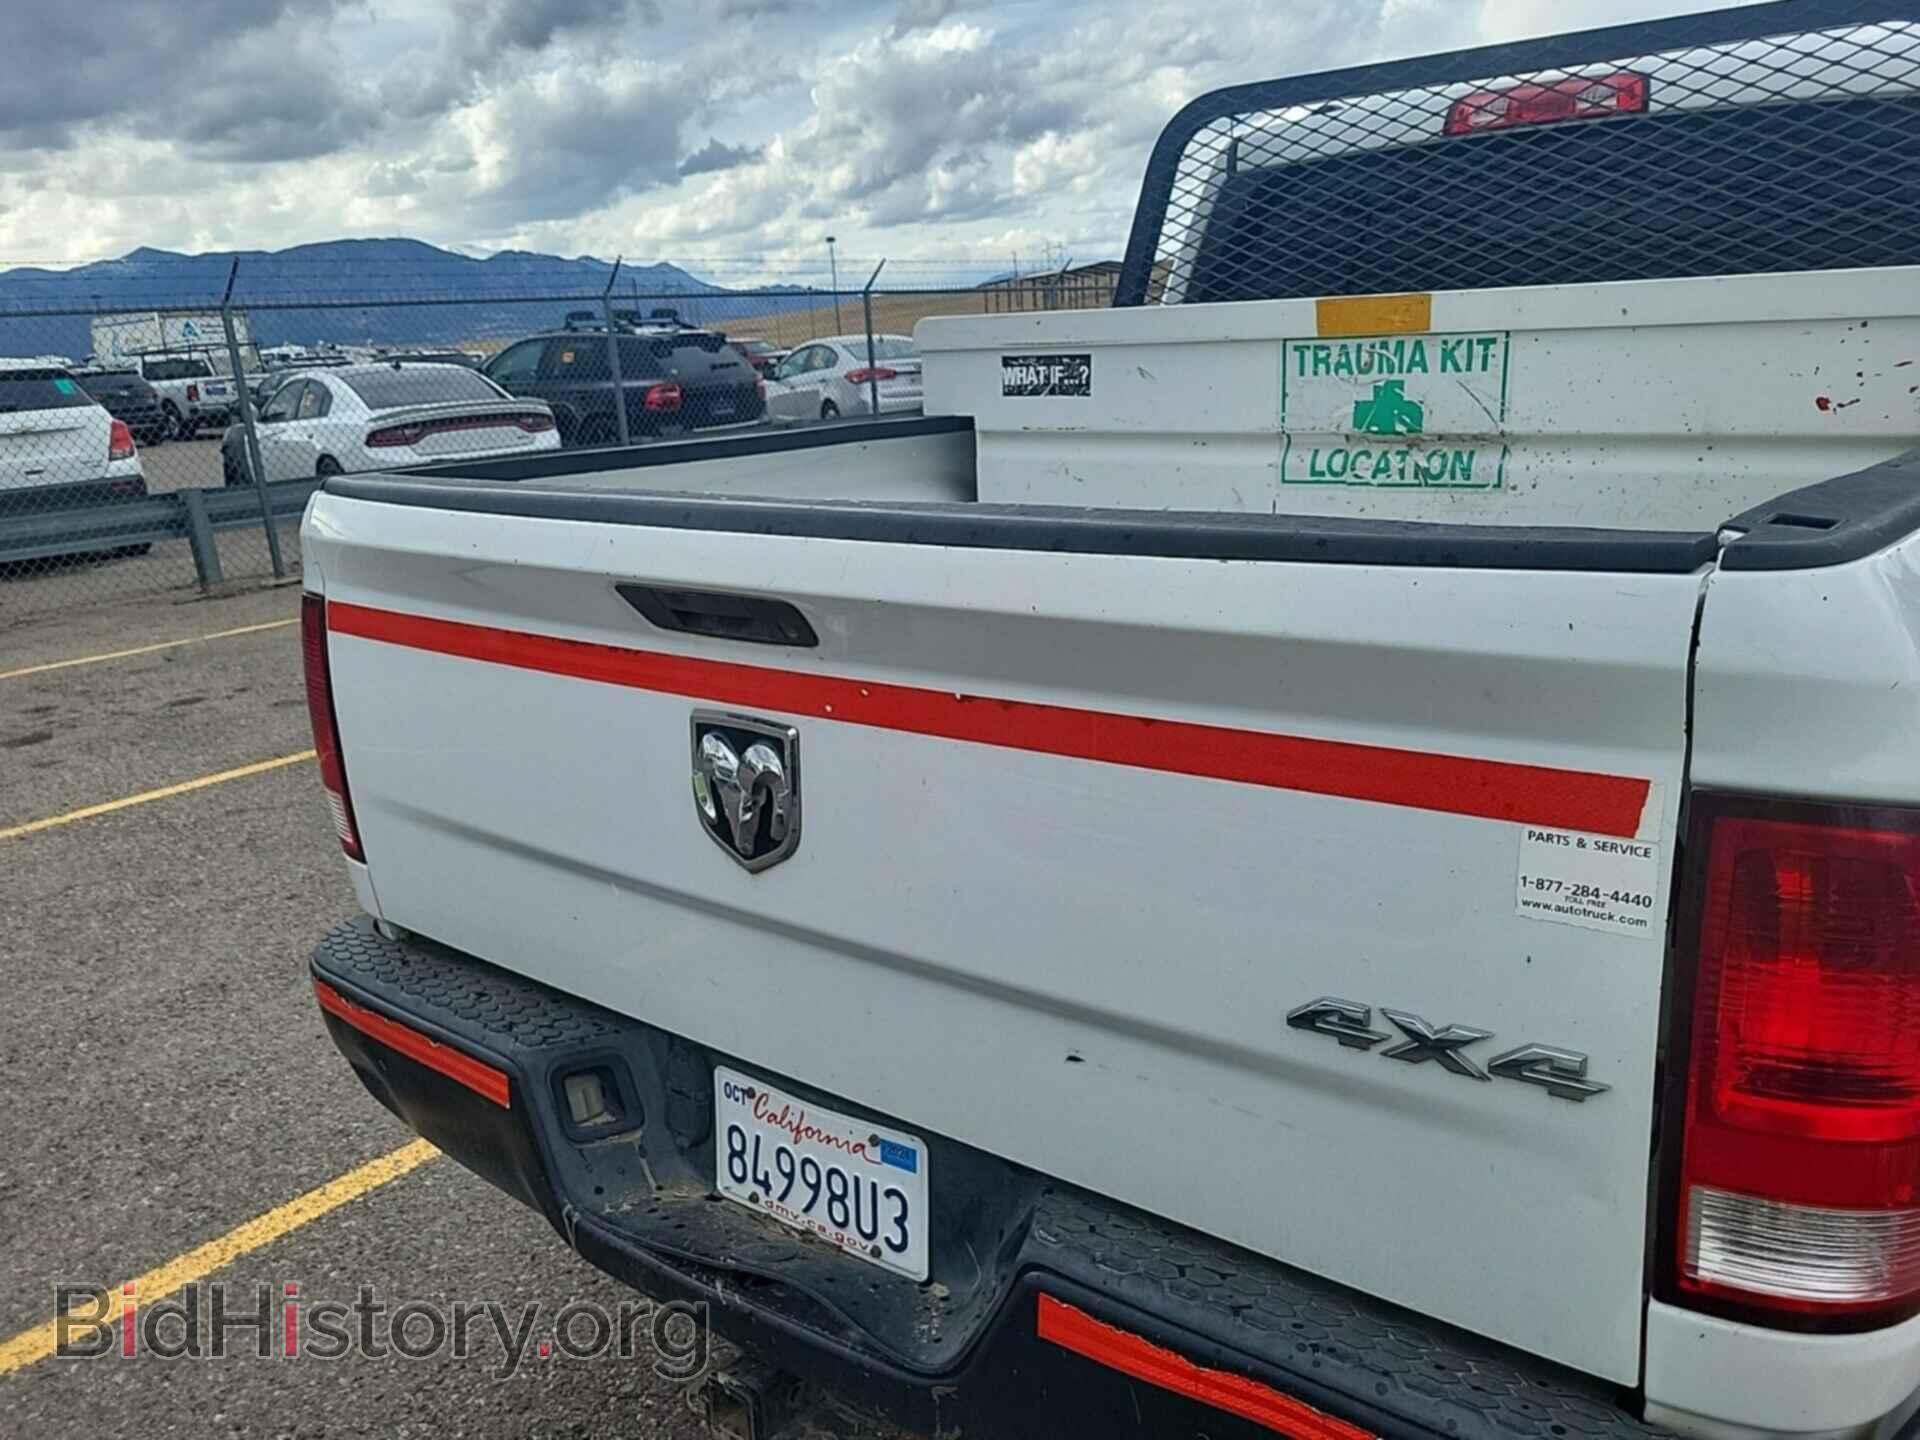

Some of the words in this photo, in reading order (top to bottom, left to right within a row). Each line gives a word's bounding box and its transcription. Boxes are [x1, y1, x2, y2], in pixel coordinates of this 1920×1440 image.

[1293, 339, 1429, 377] TRAUMA
[1439, 338, 1498, 373] KIT
[1001, 365, 1047, 386] WHAT
[1527, 830, 1571, 846] PARTS
[1576, 837, 1587, 849] &
[1593, 840, 1652, 858] SERVICE
[1520, 875, 1652, 908] 1-877-284-4440
[1521, 898, 1648, 928] www.autotruck.com
[724, 1081, 747, 1105] OCT
[753, 1092, 882, 1165] California
[727, 1124, 909, 1252] 84998U3
[764, 1199, 869, 1251] dmv.ca.gov
